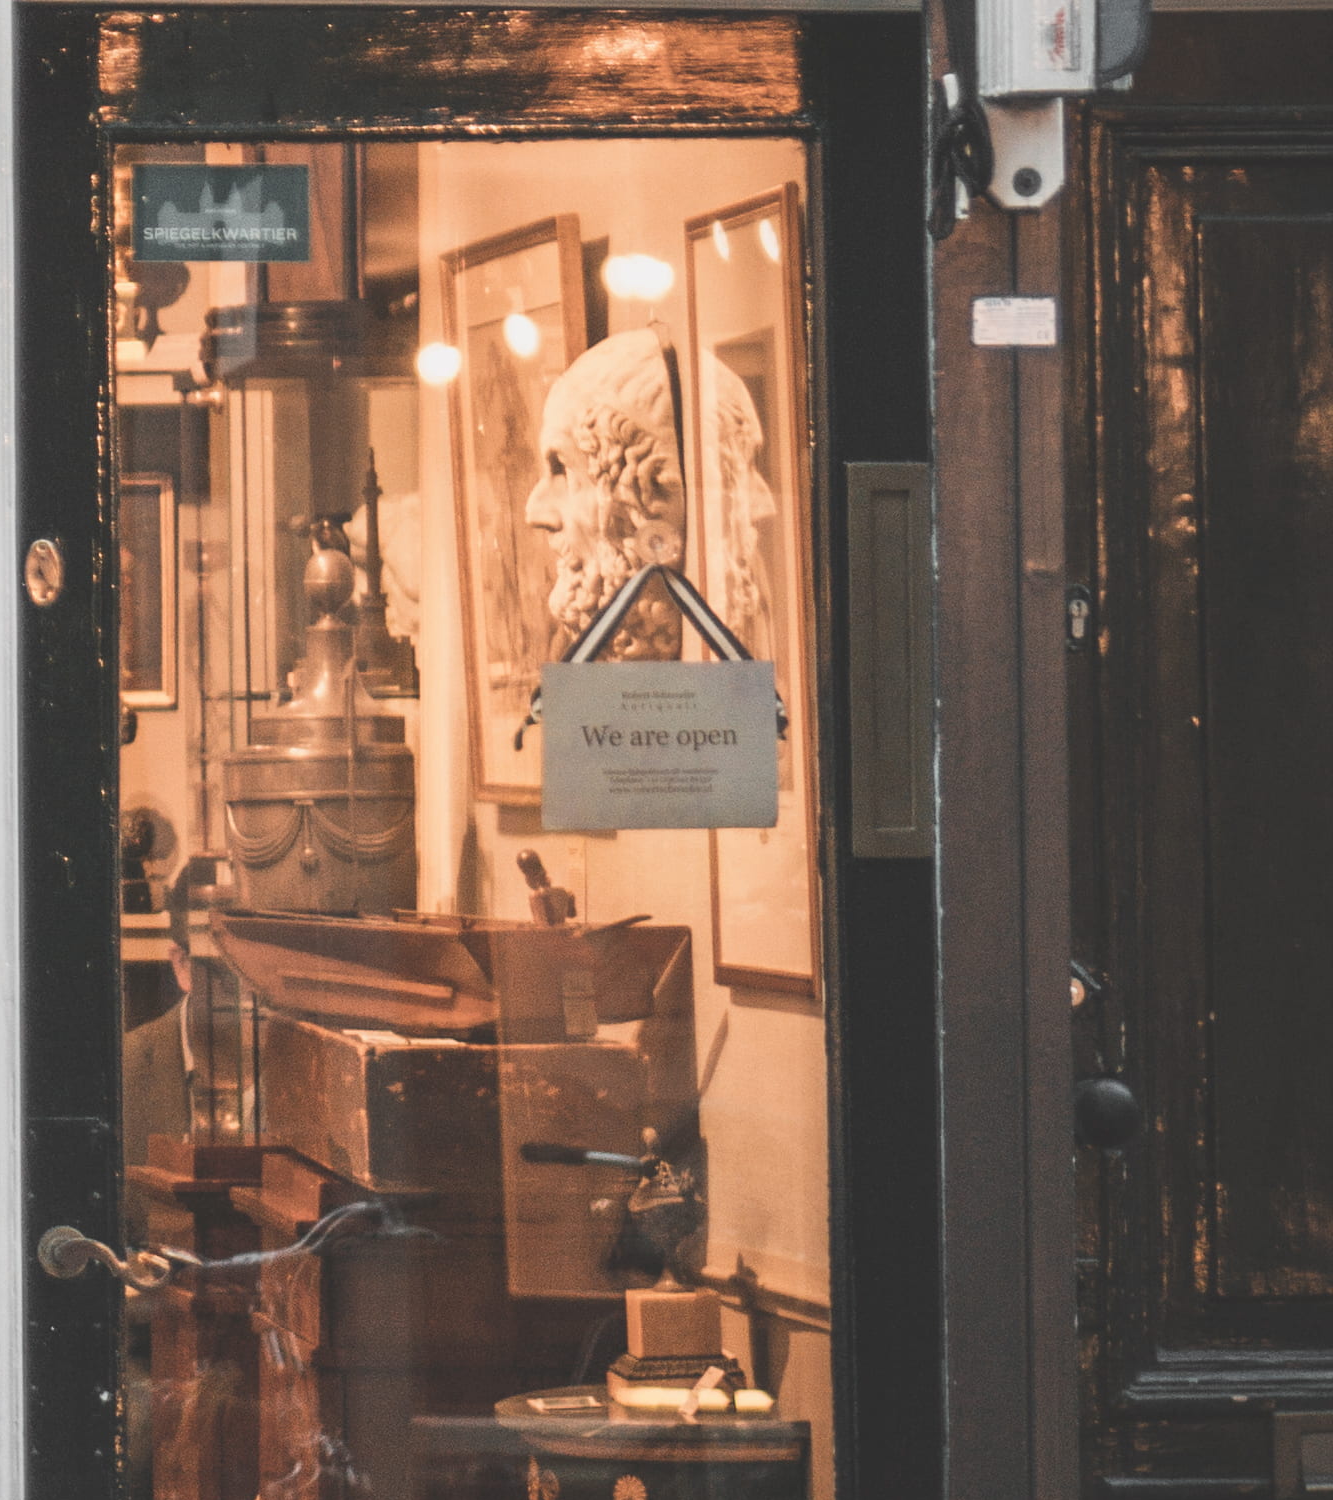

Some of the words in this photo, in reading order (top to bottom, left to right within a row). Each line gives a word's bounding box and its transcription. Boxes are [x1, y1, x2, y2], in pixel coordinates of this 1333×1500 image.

[143, 226, 298, 241] SPIEGELKWARTIER
[581, 724, 622, 746] We
[630, 728, 671, 746] are
[676, 727, 738, 750] open
